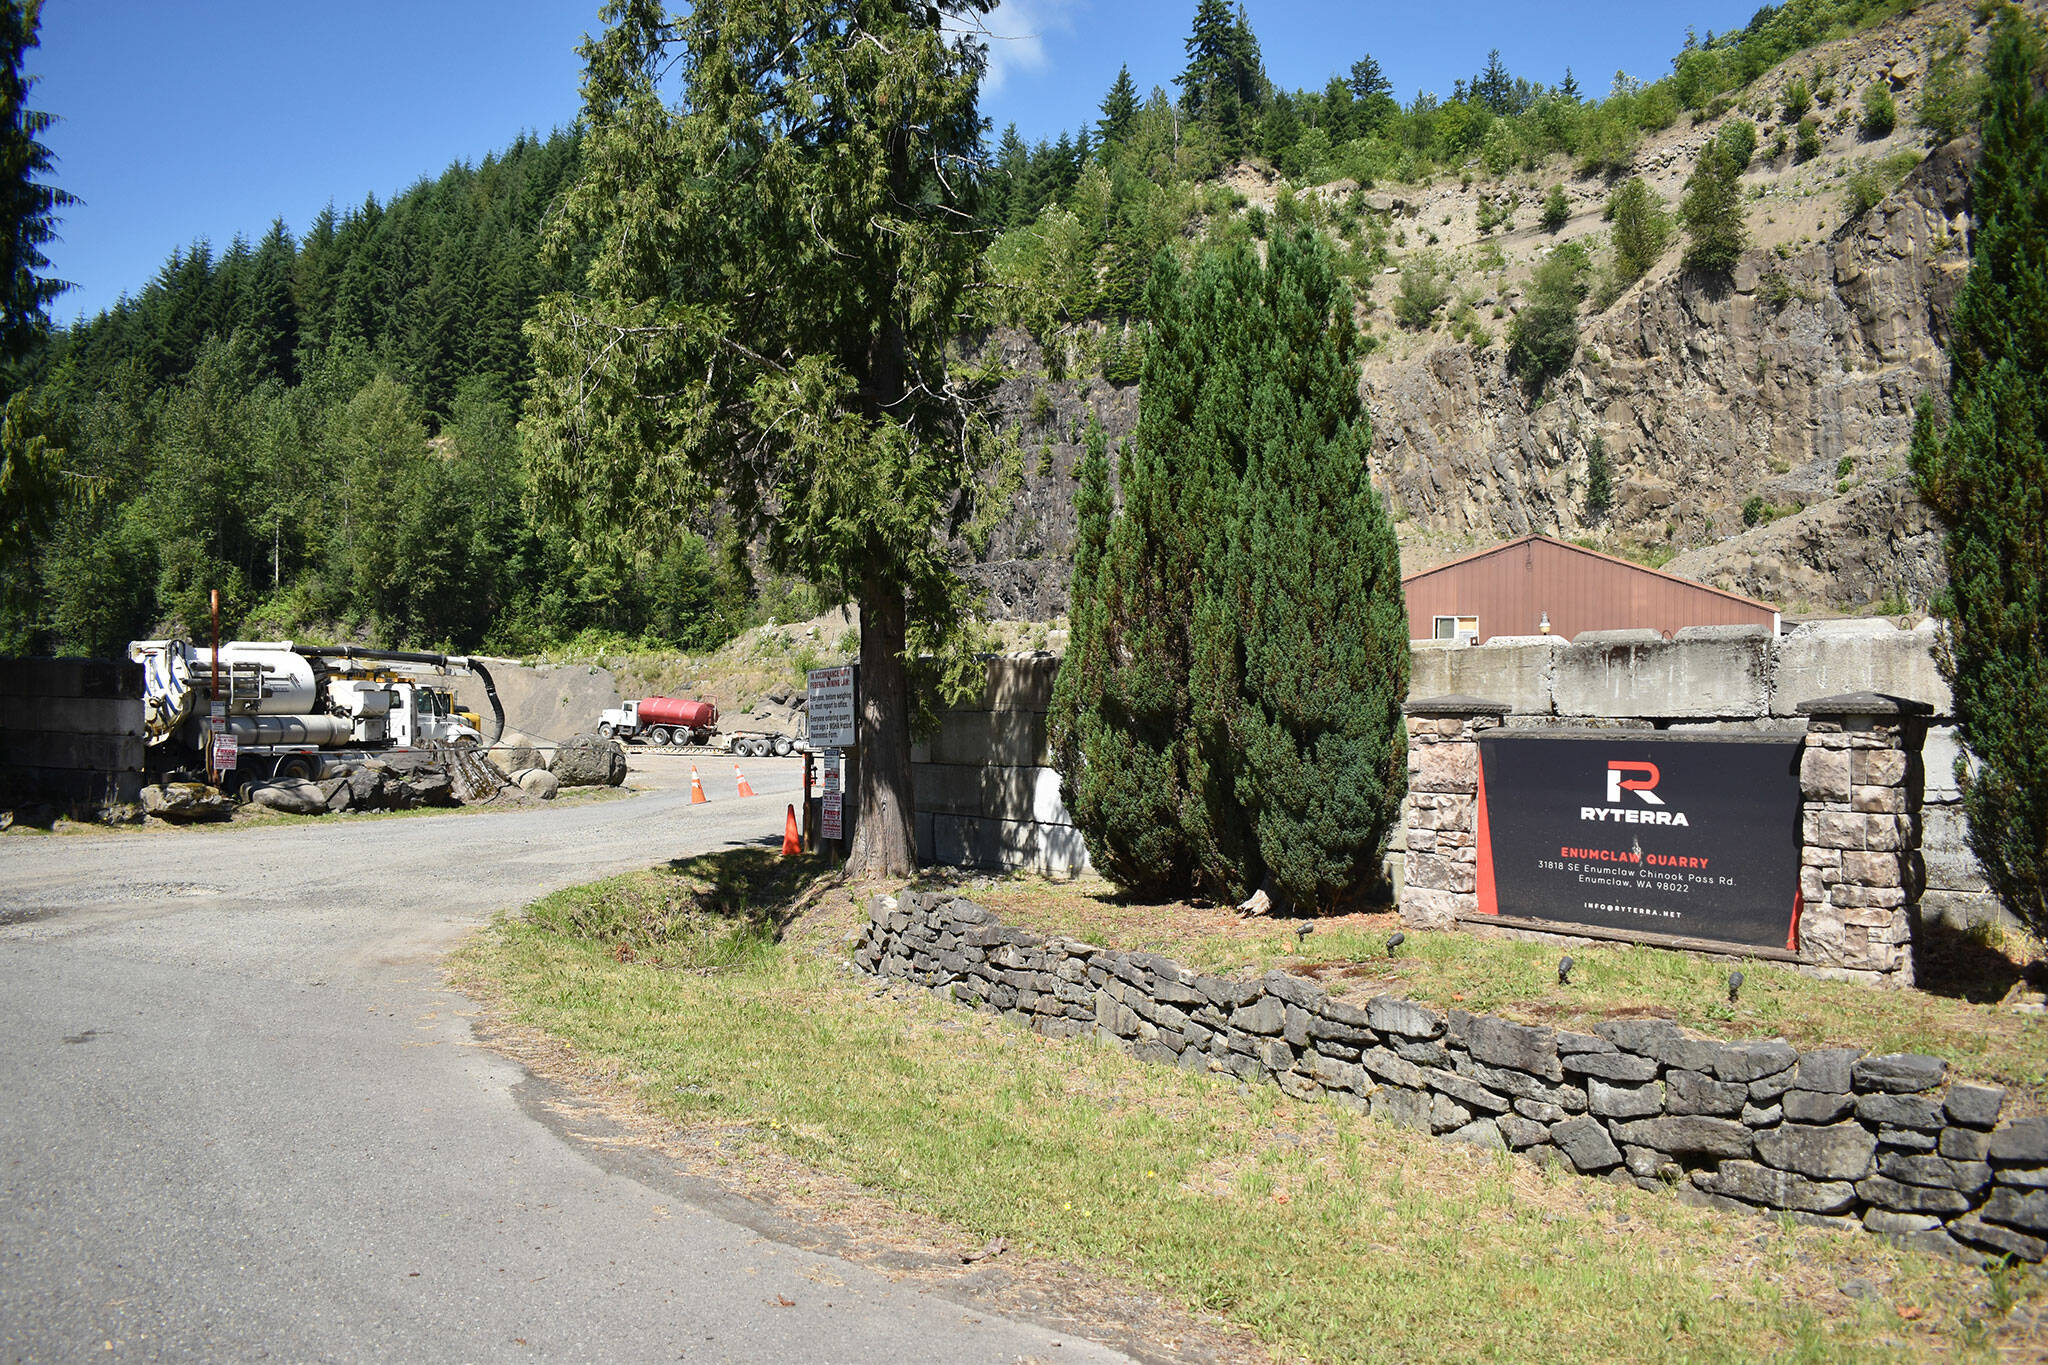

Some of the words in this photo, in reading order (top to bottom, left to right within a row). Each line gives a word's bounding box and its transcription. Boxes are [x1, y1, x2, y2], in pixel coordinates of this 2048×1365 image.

[815, 670, 839, 679] ACCORDANCE
[810, 681, 825, 689] FEDERAL
[1580, 807, 1689, 826] RYTERRA
[1561, 847, 1640, 863] ENUMCLAW
[1646, 854, 1709, 869] QUARRY
[1538, 860, 1564, 870] 31818
[1567, 863, 1580, 872] SE
[1584, 865, 1635, 877] Enumclaw
[1639, 869, 1683, 881] Chinook
[1688, 874, 1714, 884] Pass
[1719, 877, 1737, 886] Rd.
[1578, 875, 1632, 888] Enumclaw,
[1636, 880, 1652, 889] WA
[1656, 882, 1689, 893] 98022
[1584, 902, 1682, 918] INFO@RYTERRA.NET
